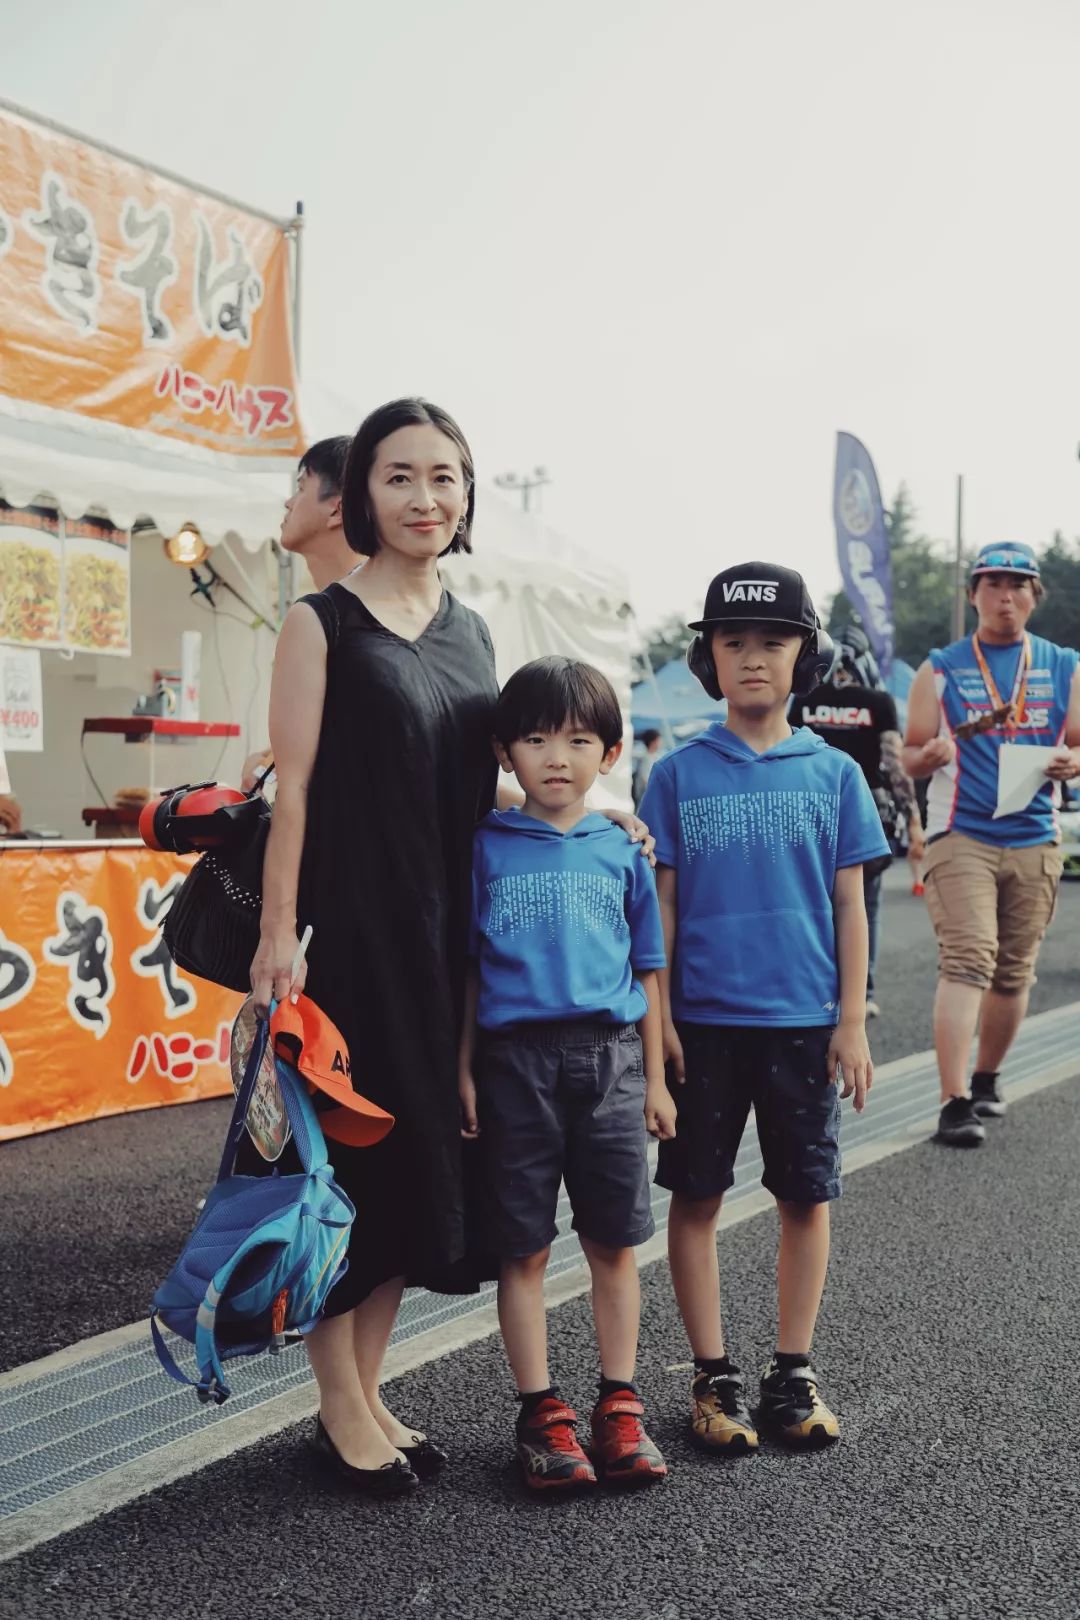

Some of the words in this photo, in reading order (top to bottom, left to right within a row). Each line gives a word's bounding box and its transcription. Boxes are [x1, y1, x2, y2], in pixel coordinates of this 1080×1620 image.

[0, 176, 260, 342] きそば
[156, 367, 290, 435] ハニーハウス
[722, 581, 779, 603] VANS
